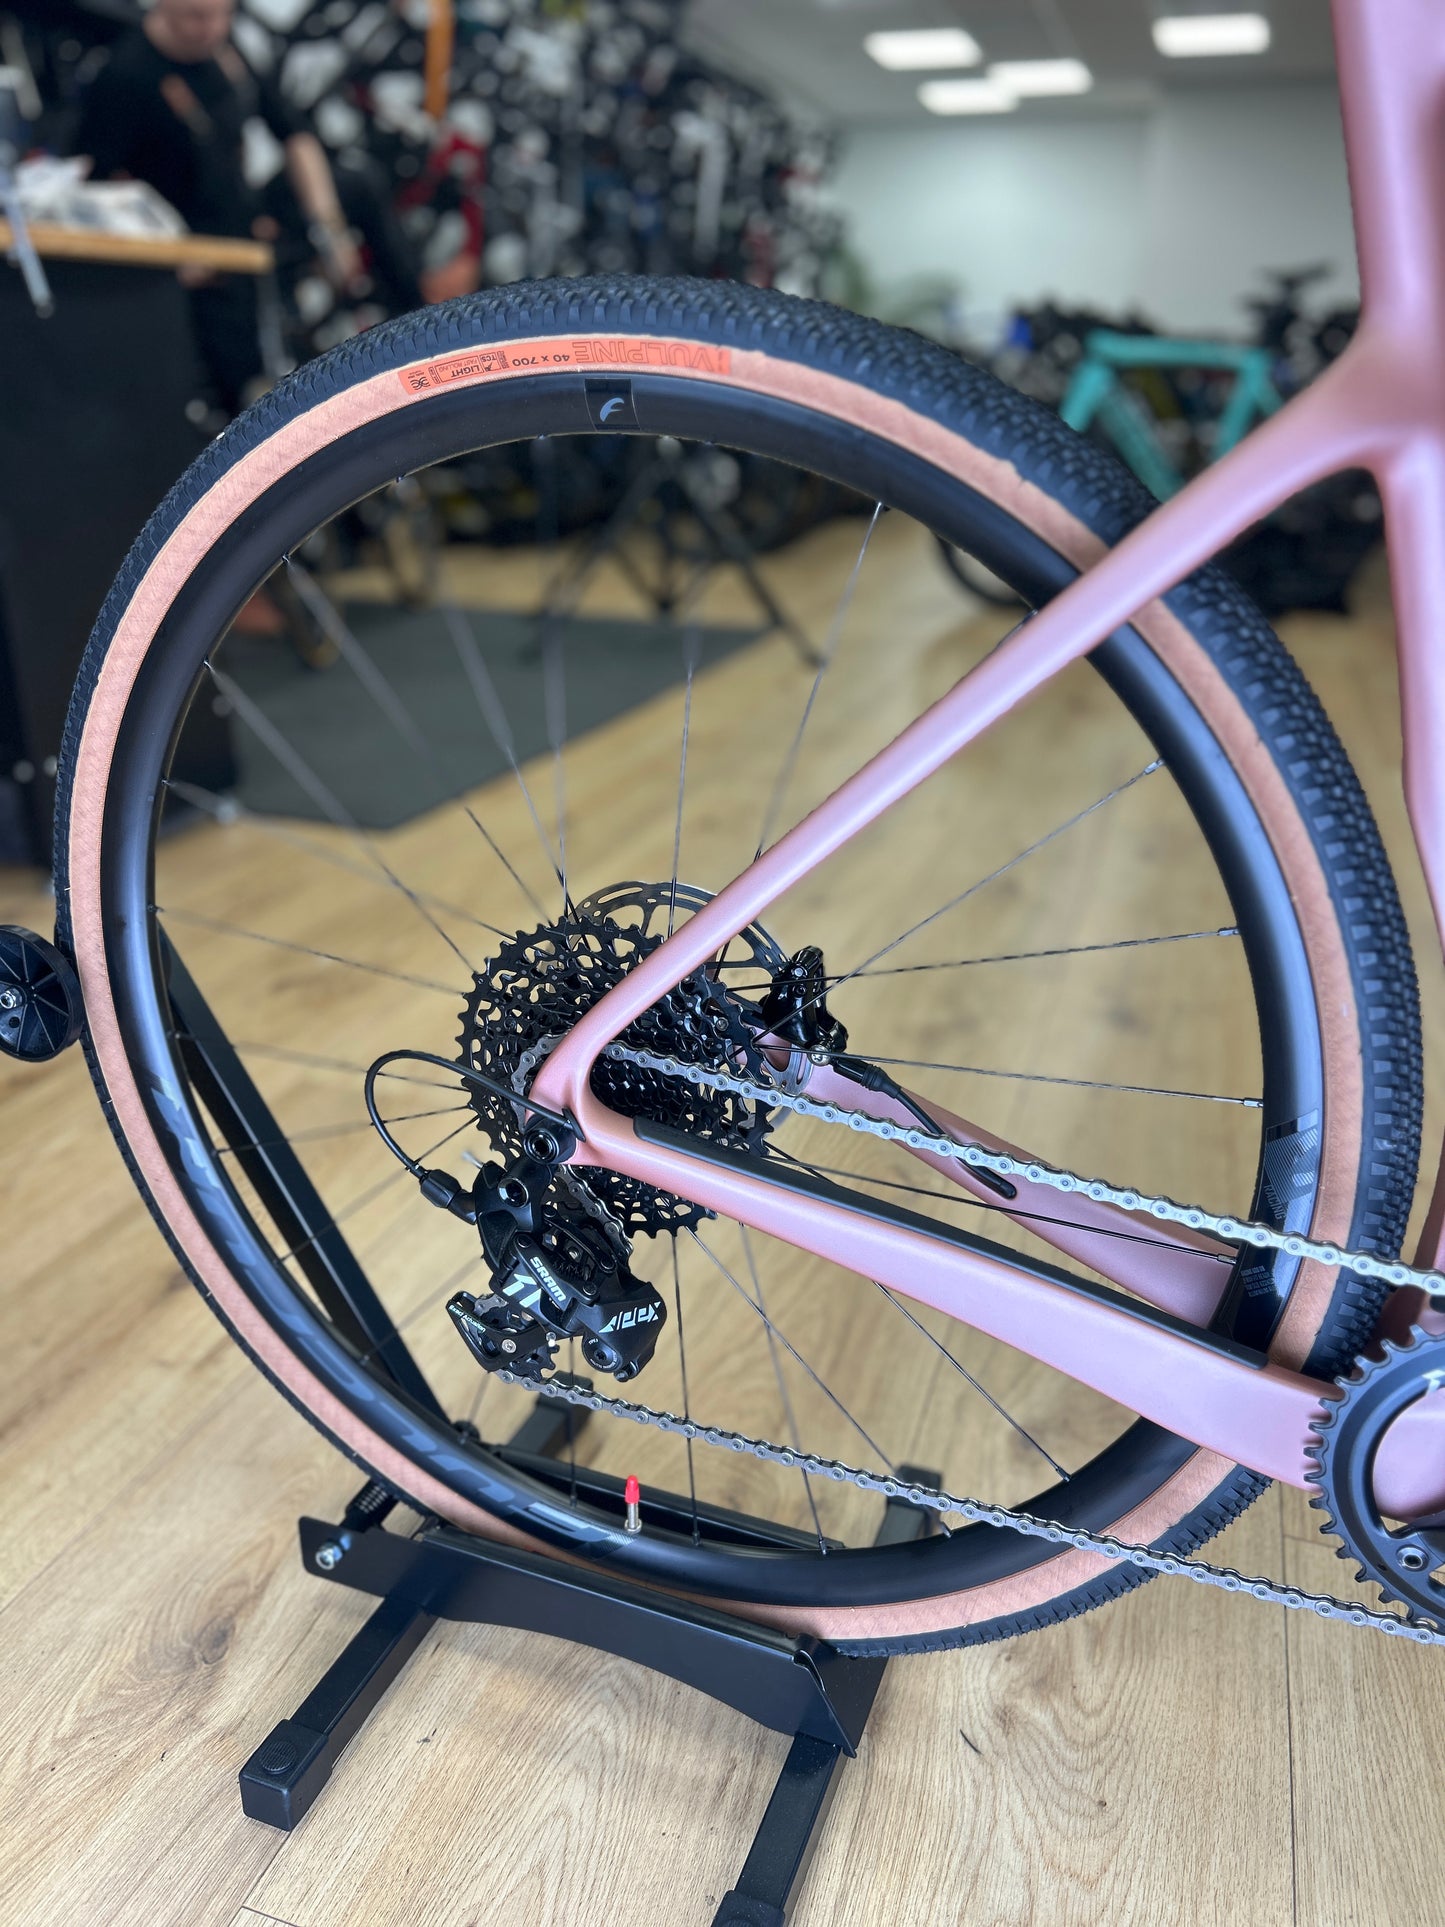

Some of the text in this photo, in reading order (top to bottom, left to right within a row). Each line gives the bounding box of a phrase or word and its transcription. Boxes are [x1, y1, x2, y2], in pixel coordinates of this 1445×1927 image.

[481, 354, 496, 363] TCS
[553, 354, 570, 363] 40
[573, 341, 714, 368] VULPINE
[512, 357, 538, 367] 700
[451, 365, 480, 378] LIGHT
[1264, 1184, 1286, 1220] RACING
[530, 1257, 566, 1301] SRAM
